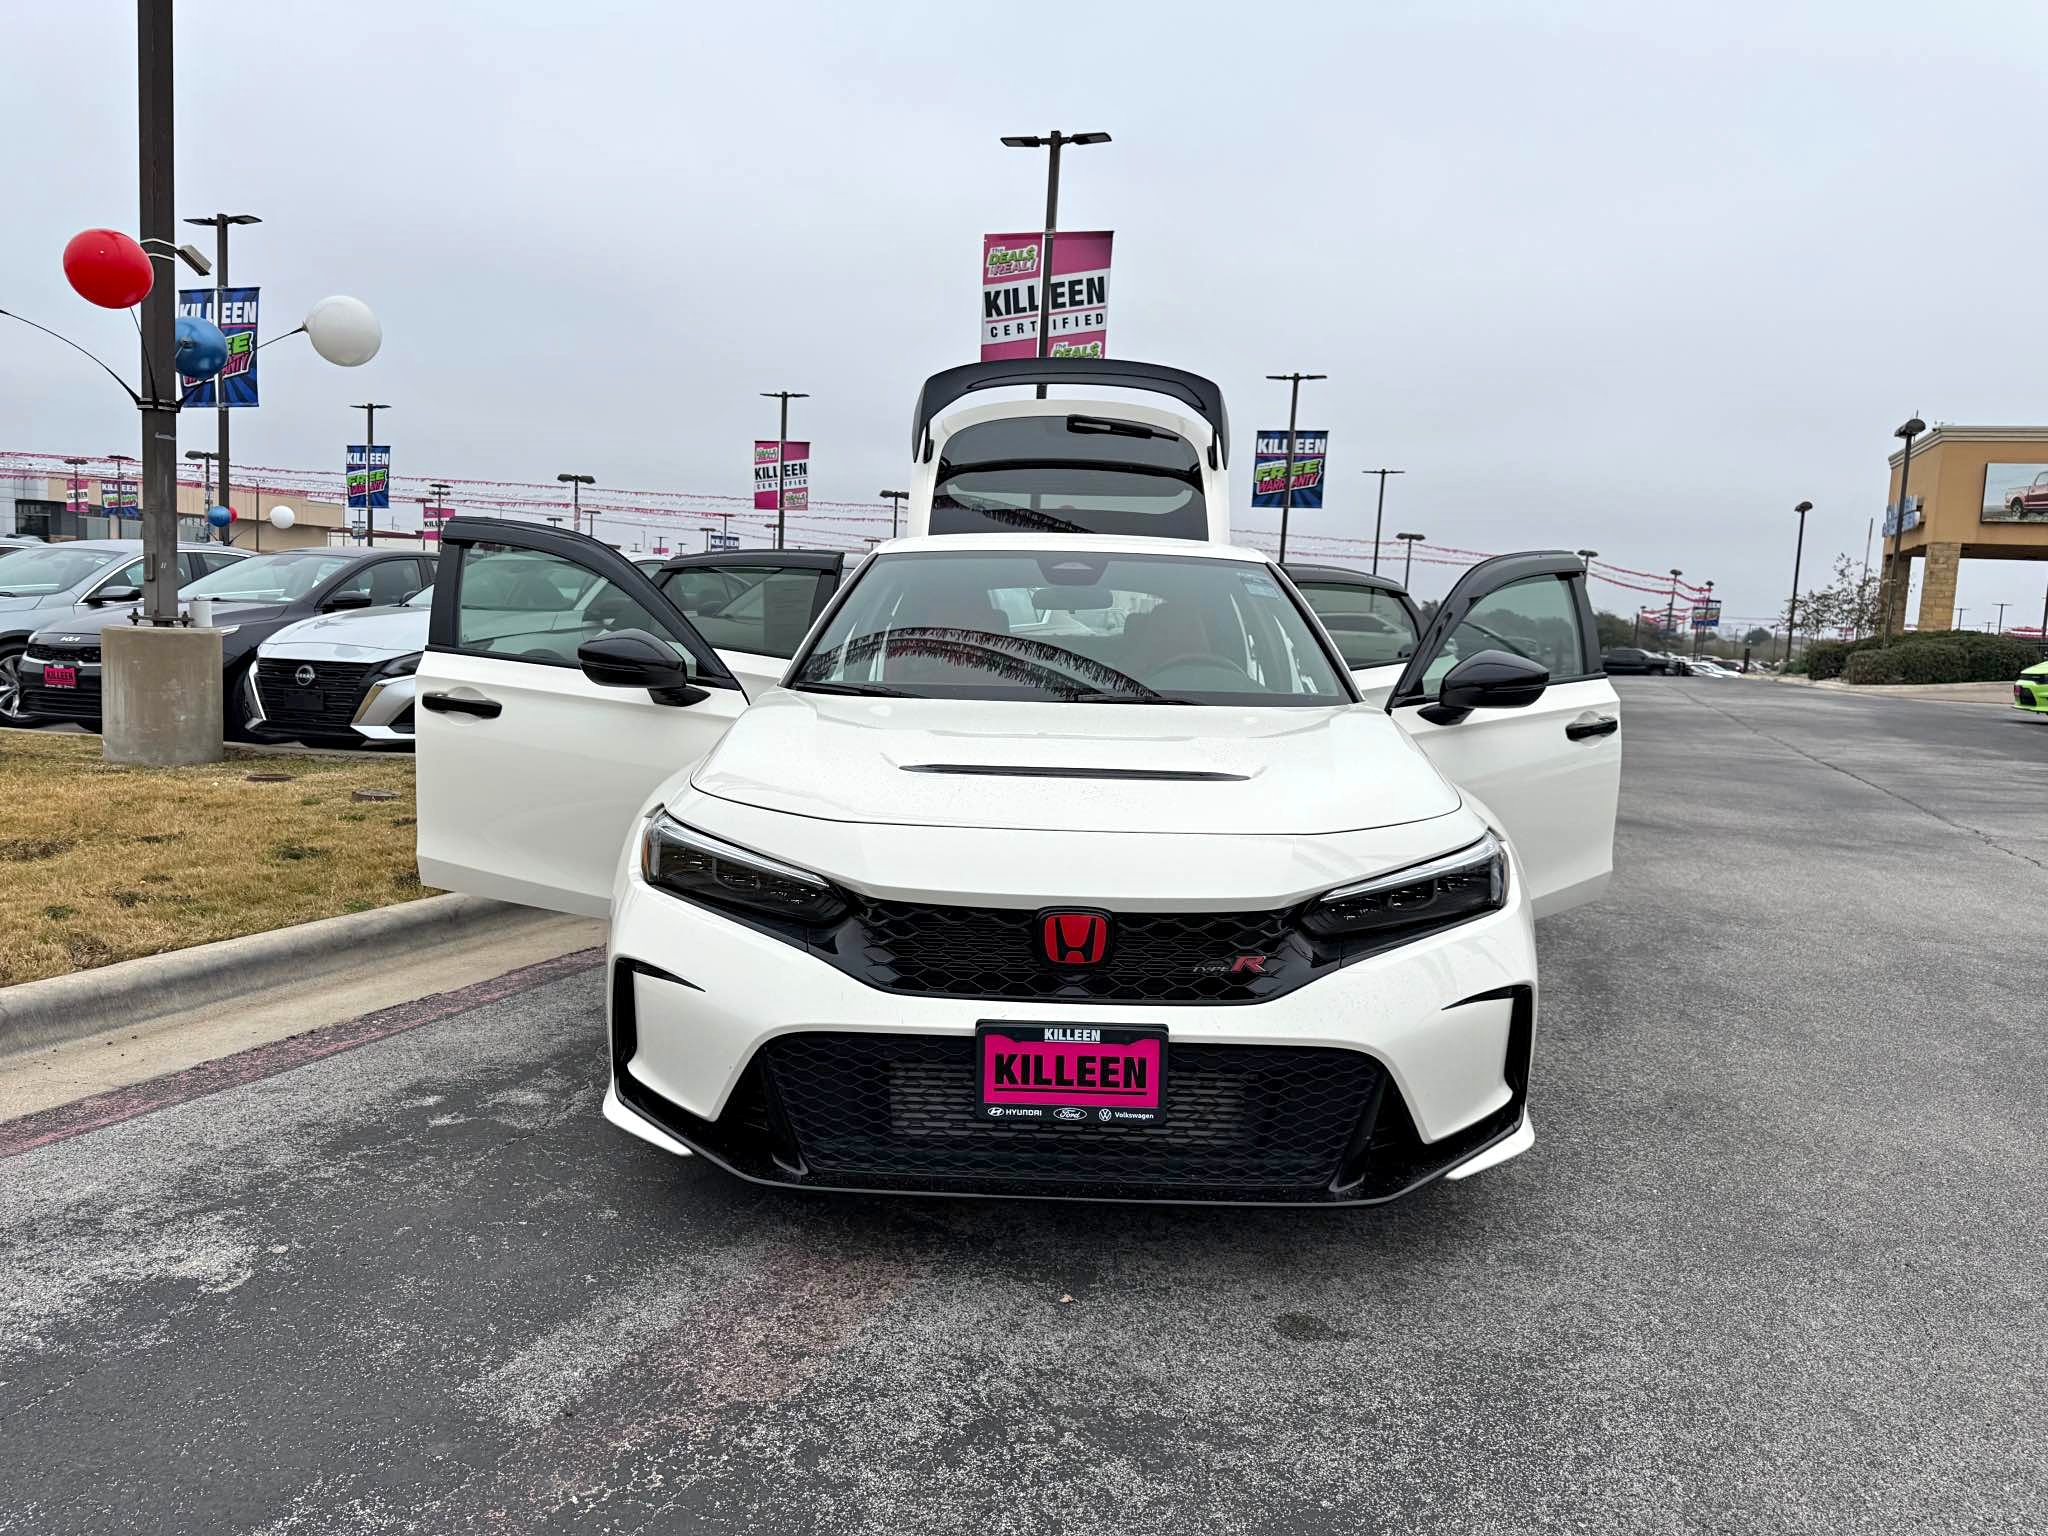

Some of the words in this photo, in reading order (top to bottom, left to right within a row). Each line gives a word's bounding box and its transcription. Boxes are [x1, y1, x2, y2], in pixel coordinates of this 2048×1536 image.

[984, 276, 1106, 318] KILLEEN
[179, 301, 257, 324] KILLEEN
[990, 313, 1104, 338] CERTIFIED
[1257, 438, 1326, 454] KILLEEN
[346, 452, 389, 465] KILLEEN
[755, 463, 807, 480] KILLEEN
[1257, 461, 1320, 481] FREE
[1231, 955, 1267, 974] R
[1044, 1028, 1101, 1042] KILLEEN
[995, 1053, 1147, 1089] KILLEEN
[1005, 1109, 1042, 1117] HYUNDAI
[1059, 1109, 1081, 1120] Ford
[1114, 1111, 1155, 1120] Volkswagen
